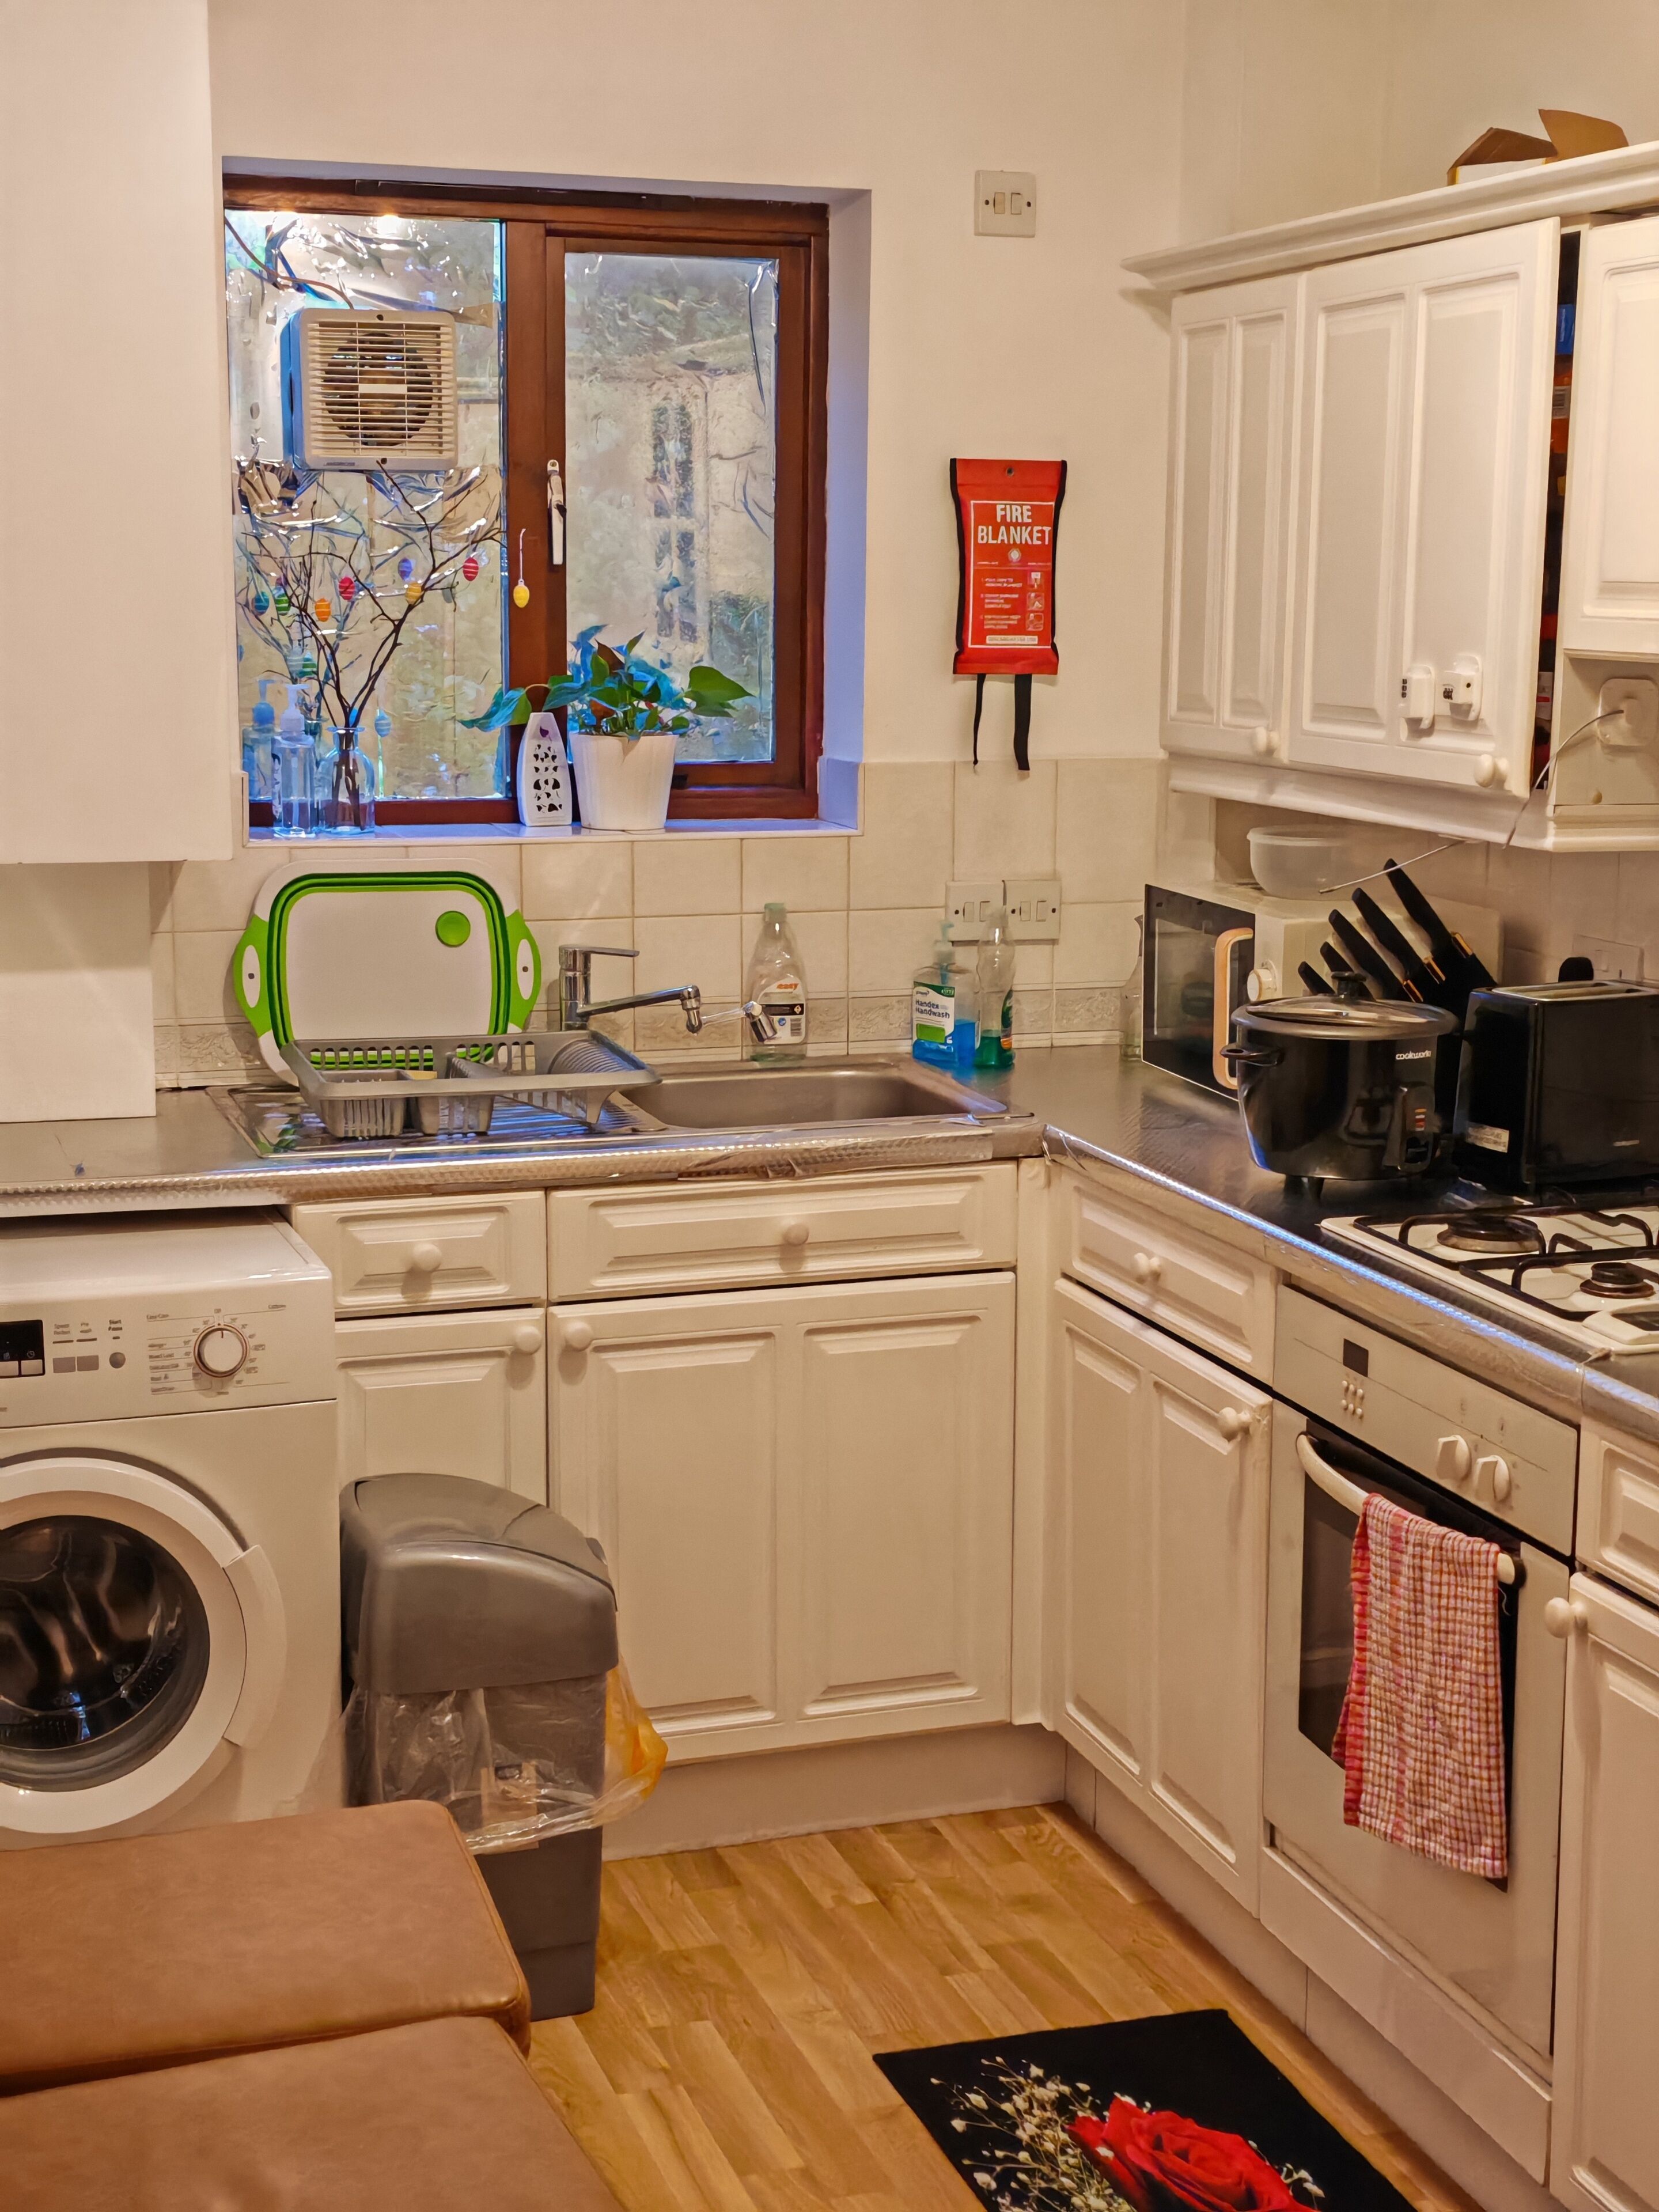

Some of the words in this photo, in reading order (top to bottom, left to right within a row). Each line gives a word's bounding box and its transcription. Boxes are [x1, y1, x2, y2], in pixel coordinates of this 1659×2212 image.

[996, 504, 1032, 522] FIRE
[978, 525, 1051, 545] BLANKET
[915, 1007, 950, 1018] Handwash
